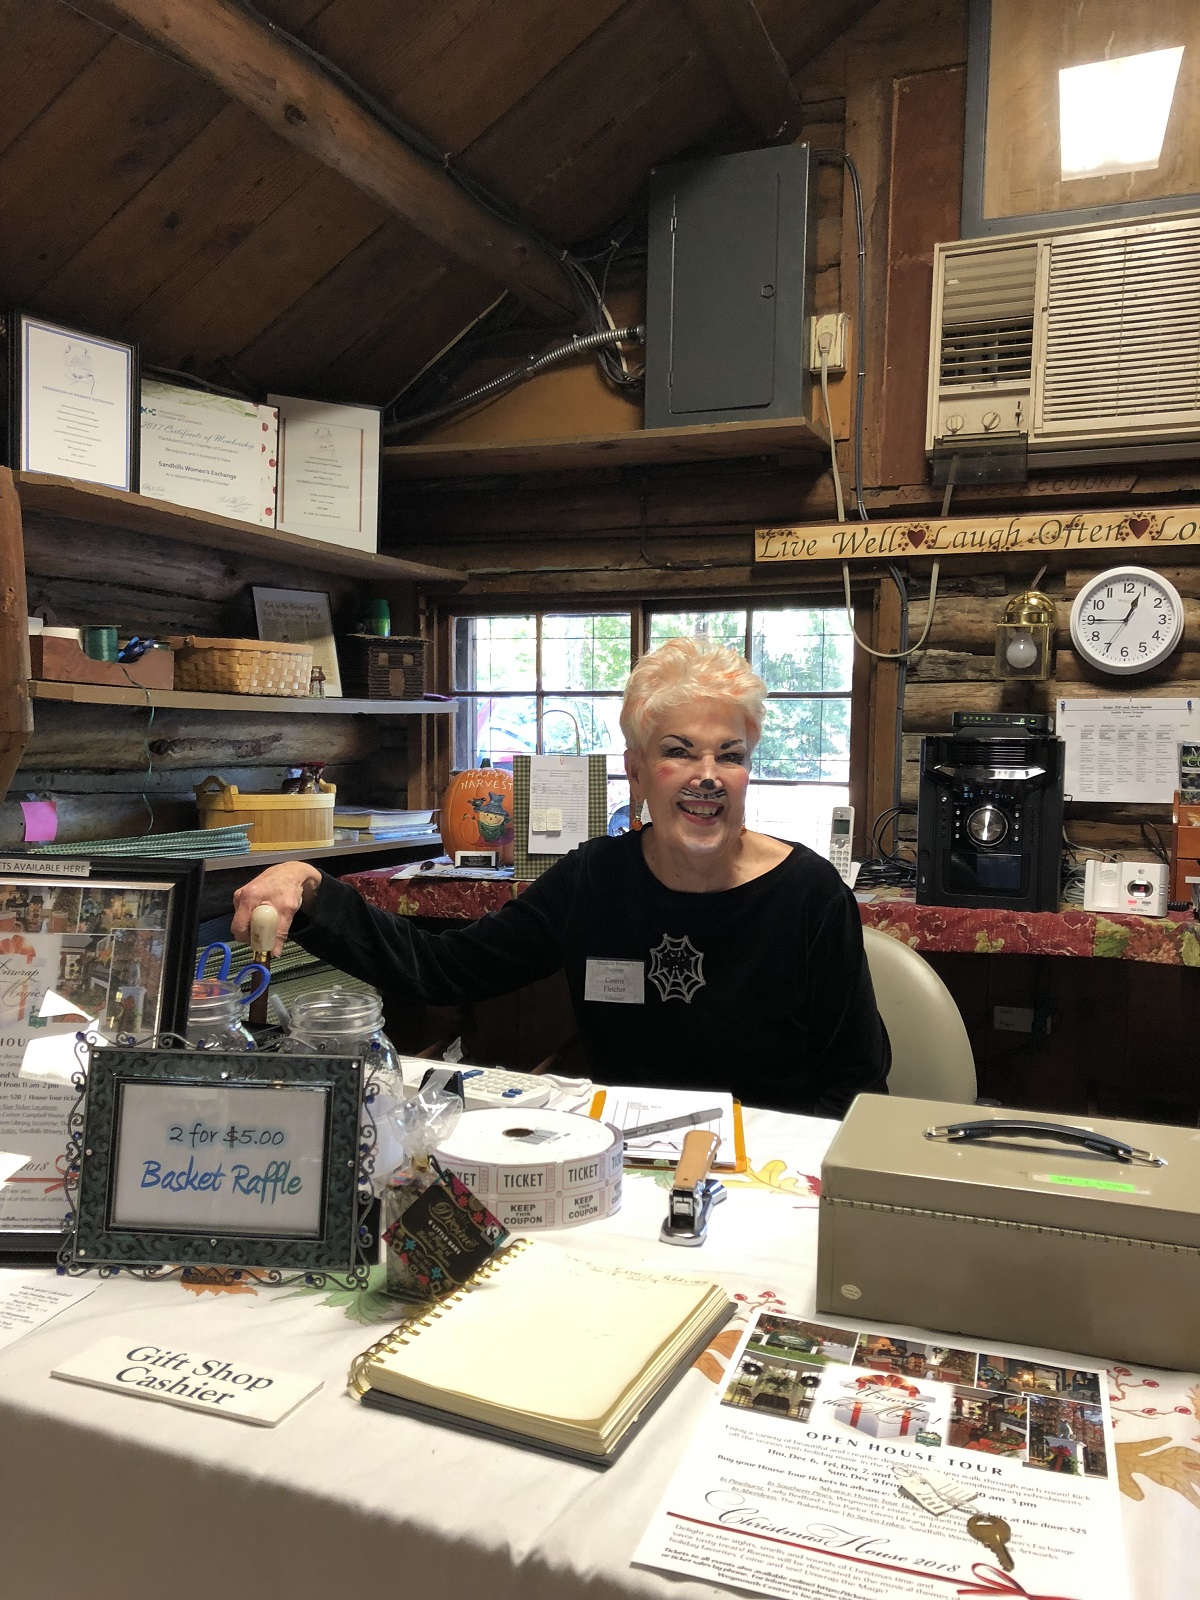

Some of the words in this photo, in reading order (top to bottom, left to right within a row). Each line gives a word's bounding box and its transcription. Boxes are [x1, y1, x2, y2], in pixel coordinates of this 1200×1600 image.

[158, 460, 184, 471] Sandhills
[184, 465, 210, 476] Women's
[211, 470, 237, 480] Exchange
[759, 535, 818, 558] Live
[832, 525, 903, 556] Well
[931, 518, 1021, 552] Laugh
[1038, 514, 1123, 548] Often
[1153, 515, 1200, 542] Lo
[1106, 587, 1113, 598] 11
[1124, 582, 1136, 594] 12
[1093, 600, 1105, 610] 10
[1153, 598, 1162, 608] 2
[1087, 614, 1096, 626] 9
[1158, 614, 1167, 625] 3
[1091, 630, 1100, 642] 8
[1152, 630, 1161, 641] 4
[1104, 642, 1112, 653] 7
[1120, 646, 1129, 658] 6
[1138, 642, 1148, 653] 5
[466, 770, 510, 780] HAPPY
[460, 778, 513, 790] HARVEST
[14, 862, 60, 872] AVAILABLE
[63, 864, 86, 873] HERE
[169, 1126, 184, 1142] 2
[188, 1122, 220, 1148] for
[222, 1126, 285, 1150] $5.00
[456, 1172, 476, 1186] KET
[568, 1163, 598, 1183] TICKET
[140, 1155, 227, 1192] Basket
[231, 1160, 304, 1206] Raffle
[504, 1174, 544, 1188] TICKET
[574, 1195, 594, 1206] KEEP
[510, 1204, 536, 1212] KEEP
[568, 1206, 598, 1220] COUPON
[430, 1201, 478, 1249] Divine
[504, 1216, 543, 1225] COUPON
[432, 1224, 448, 1242] LITTLE
[126, 1345, 192, 1372] Gift
[192, 1359, 274, 1392] Shop
[114, 1366, 236, 1405] Cashier
[804, 1448, 833, 1458] holiday
[806, 1430, 859, 1448] OPEN
[868, 1443, 937, 1463] HOUSE
[947, 1458, 1004, 1477] TOUR
[756, 1433, 781, 1442] variety
[793, 1440, 828, 1450] beautiful
[984, 1478, 1018, 1488] through
[789, 1453, 806, 1461] Dec
[840, 1464, 858, 1472] Dec
[850, 1473, 868, 1482] Dec
[717, 1454, 734, 1463] Buy
[758, 1464, 785, 1473] House
[788, 1470, 806, 1478] Tour
[808, 1475, 837, 1485] tickets
[851, 1485, 889, 1496] advance:
[1040, 1522, 1067, 1531] door:
[776, 1483, 810, 1494] Southern
[836, 1496, 879, 1508] Weymouth
[704, 1489, 824, 1544] Christmas
[806, 1522, 908, 1562] House
[911, 1558, 960, 1572] 2018
[665, 1547, 689, 1556] Tickets
[675, 1524, 704, 1535] Delight
[760, 1546, 785, 1555] smells
[806, 1557, 835, 1567] sounds
[849, 1567, 892, 1580] Christmas
[669, 1537, 699, 1549] holiday
[740, 1554, 764, 1563] Come
[804, 1570, 838, 1582] Unwrap
[696, 1537, 716, 1546] tasty
[718, 1543, 745, 1551] treats!
[747, 1549, 774, 1559] Rooms
[806, 1564, 851, 1578] decorated
[880, 1582, 913, 1592] musical
[916, 1589, 948, 1599] themes
